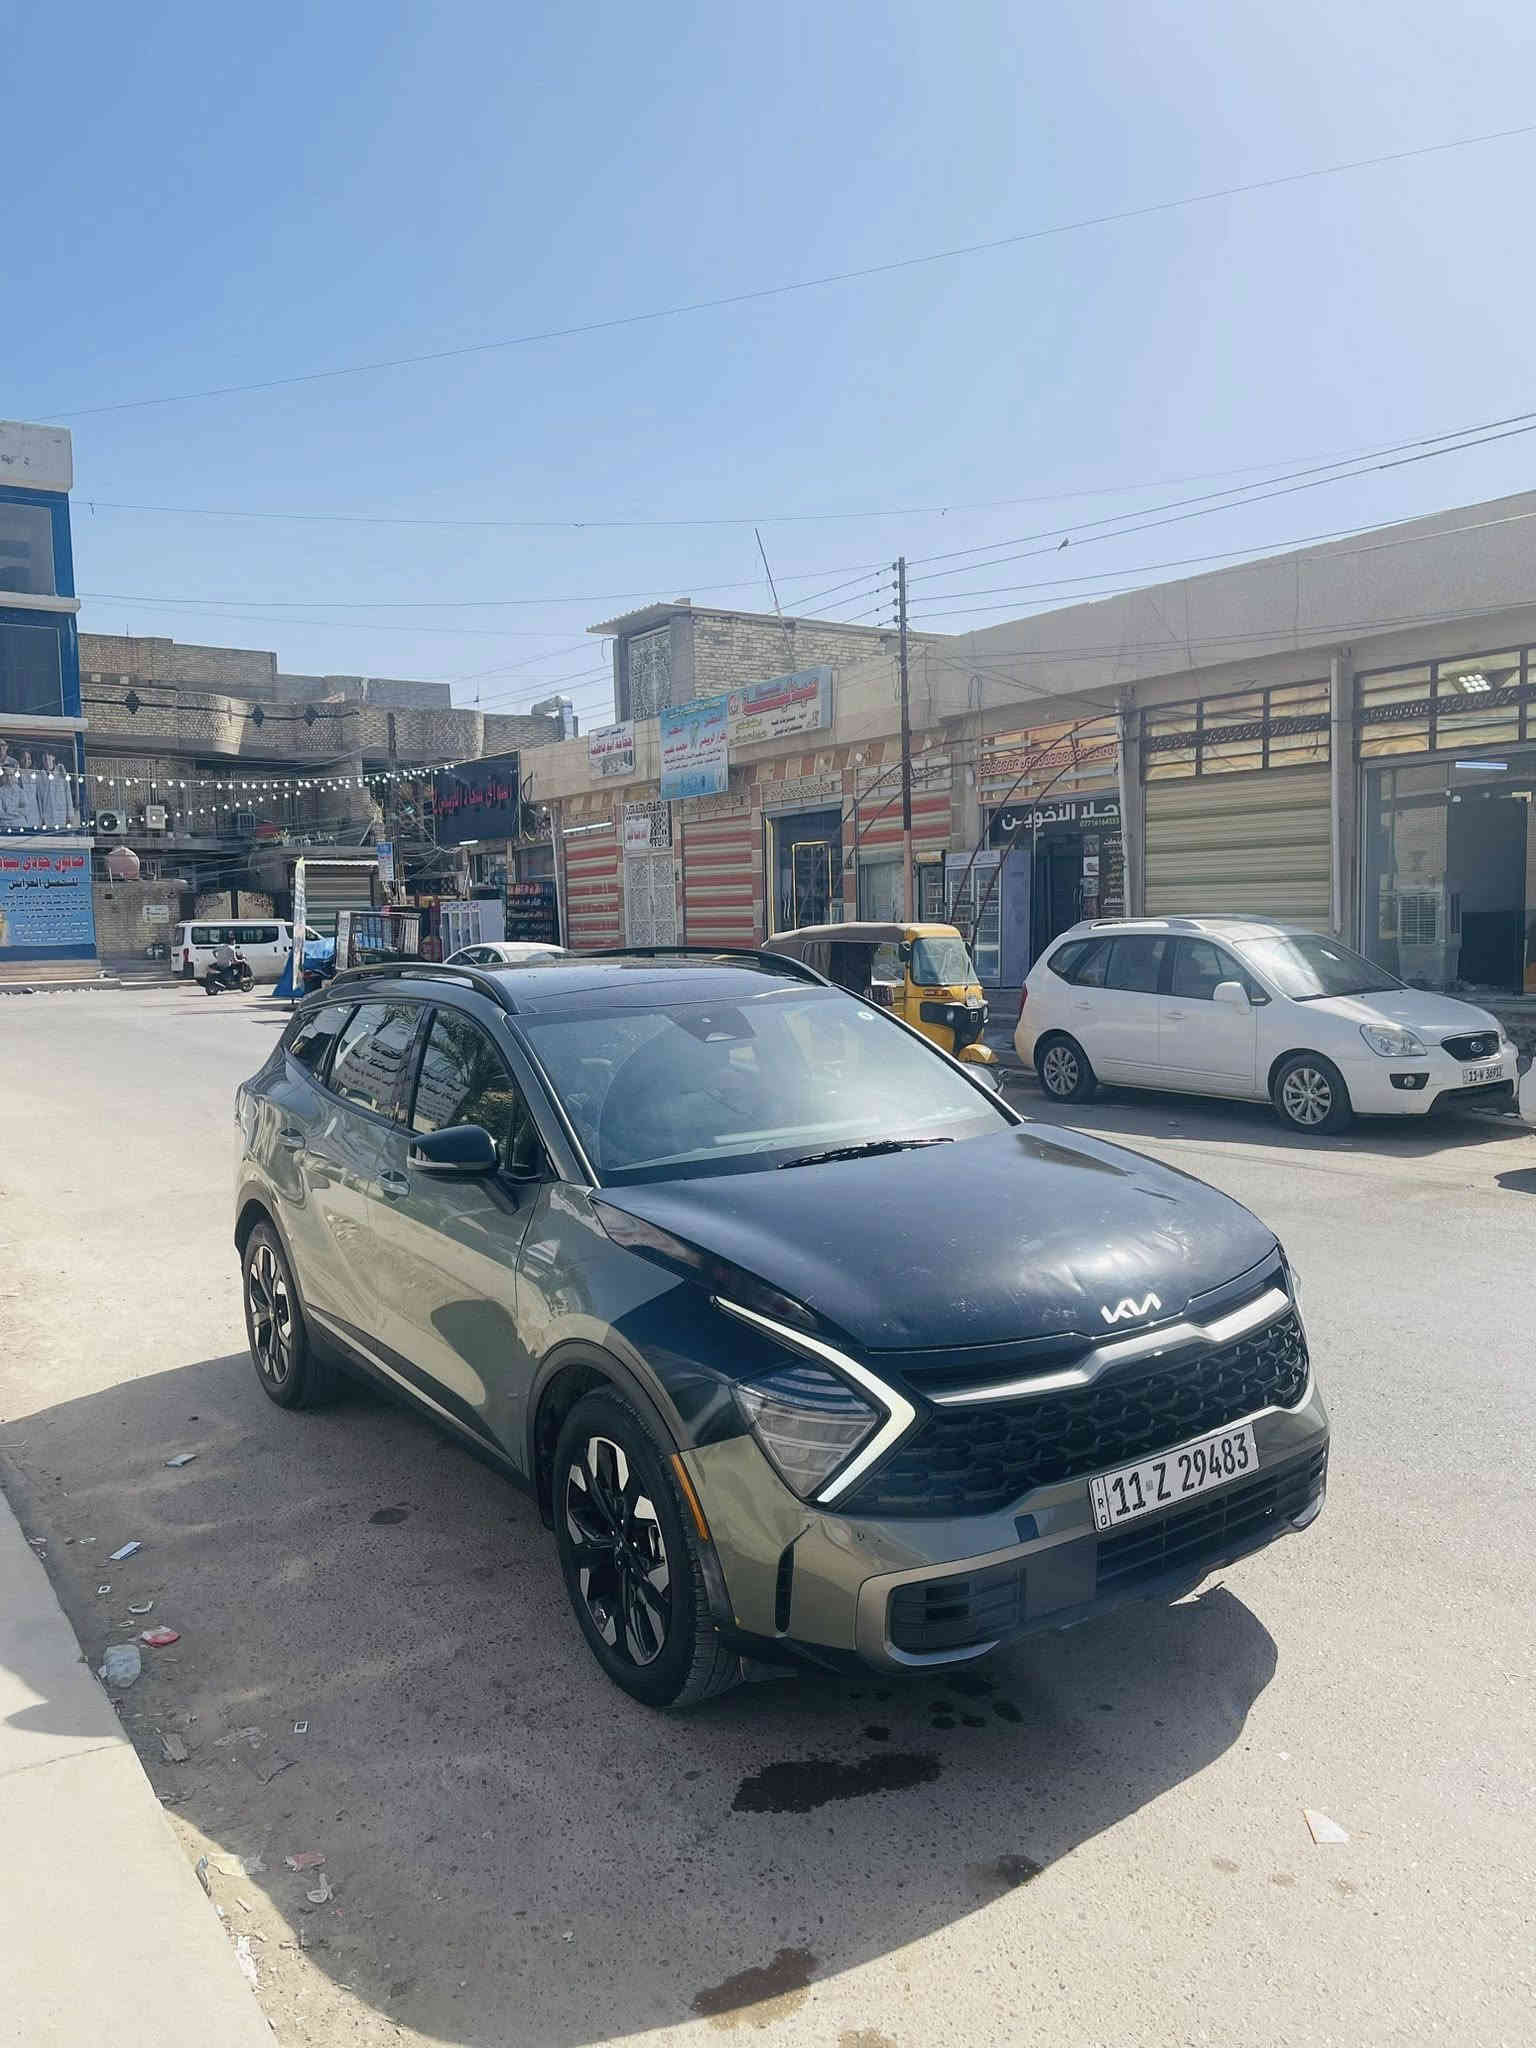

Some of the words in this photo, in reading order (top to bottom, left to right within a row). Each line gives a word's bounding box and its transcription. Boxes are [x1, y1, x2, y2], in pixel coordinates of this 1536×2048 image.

[1001, 802, 1076, 831] الأخوين
[1112, 1472, 1146, 1516] 11
[1153, 1462, 1171, 1500] Z
[1179, 1432, 1249, 1491] 29483
